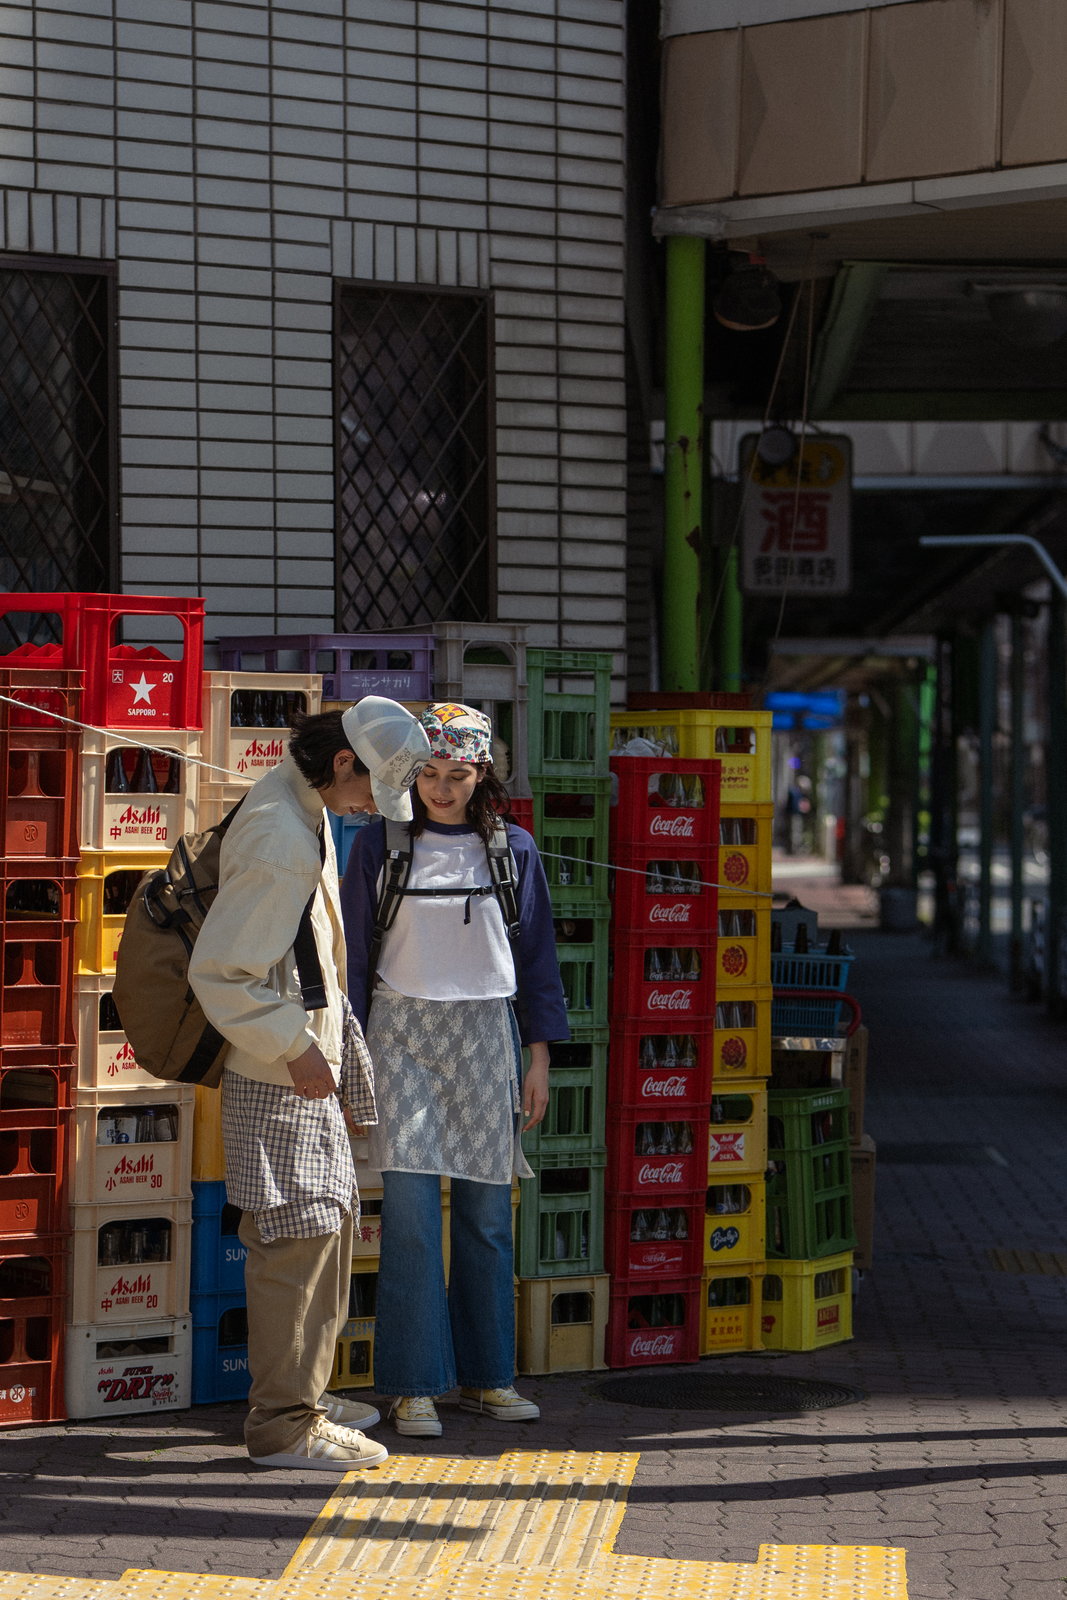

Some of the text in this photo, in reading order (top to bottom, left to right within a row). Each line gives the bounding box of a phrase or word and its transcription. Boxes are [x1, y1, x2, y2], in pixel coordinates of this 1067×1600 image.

[760, 491, 831, 553] 酒
[162, 672, 174, 683] 20
[351, 676, 411, 688] ニホンサカリ
[127, 707, 156, 717] SAPPORO
[245, 739, 283, 757] Asahi
[237, 758, 248, 773] 小
[251, 759, 265, 767] ASAHI
[265, 759, 277, 767] BEER
[119, 804, 161, 824] Asahi
[110, 825, 122, 840] 中
[124, 826, 153, 835] ASAHI BEER
[649, 815, 695, 837] Coca-Cola
[155, 827, 168, 841] 20
[649, 903, 693, 923] Coca-Cola
[647, 989, 693, 1010] Coca-Cola
[107, 1062, 119, 1077] 小
[122, 1062, 136, 1070] ASAHI
[641, 1076, 688, 1098] Coca-Cola
[114, 1153, 154, 1175] Asahi
[119, 1175, 148, 1184] ASAHI BEER
[638, 1162, 685, 1185] Coca-Cola
[105, 1177, 117, 1191] 小
[150, 1174, 163, 1188] 30
[225, 1248, 249, 1262] SUN
[110, 1274, 151, 1296] Asahi
[101, 1298, 112, 1312] 中
[115, 1295, 144, 1305] ASAHI BEER
[146, 1295, 158, 1308] 20
[630, 1334, 676, 1358] Coca-Cola
[98, 1366, 114, 1375] Asahi
[122, 1366, 154, 1377] SUPER
[222, 1358, 249, 1372] SUN
